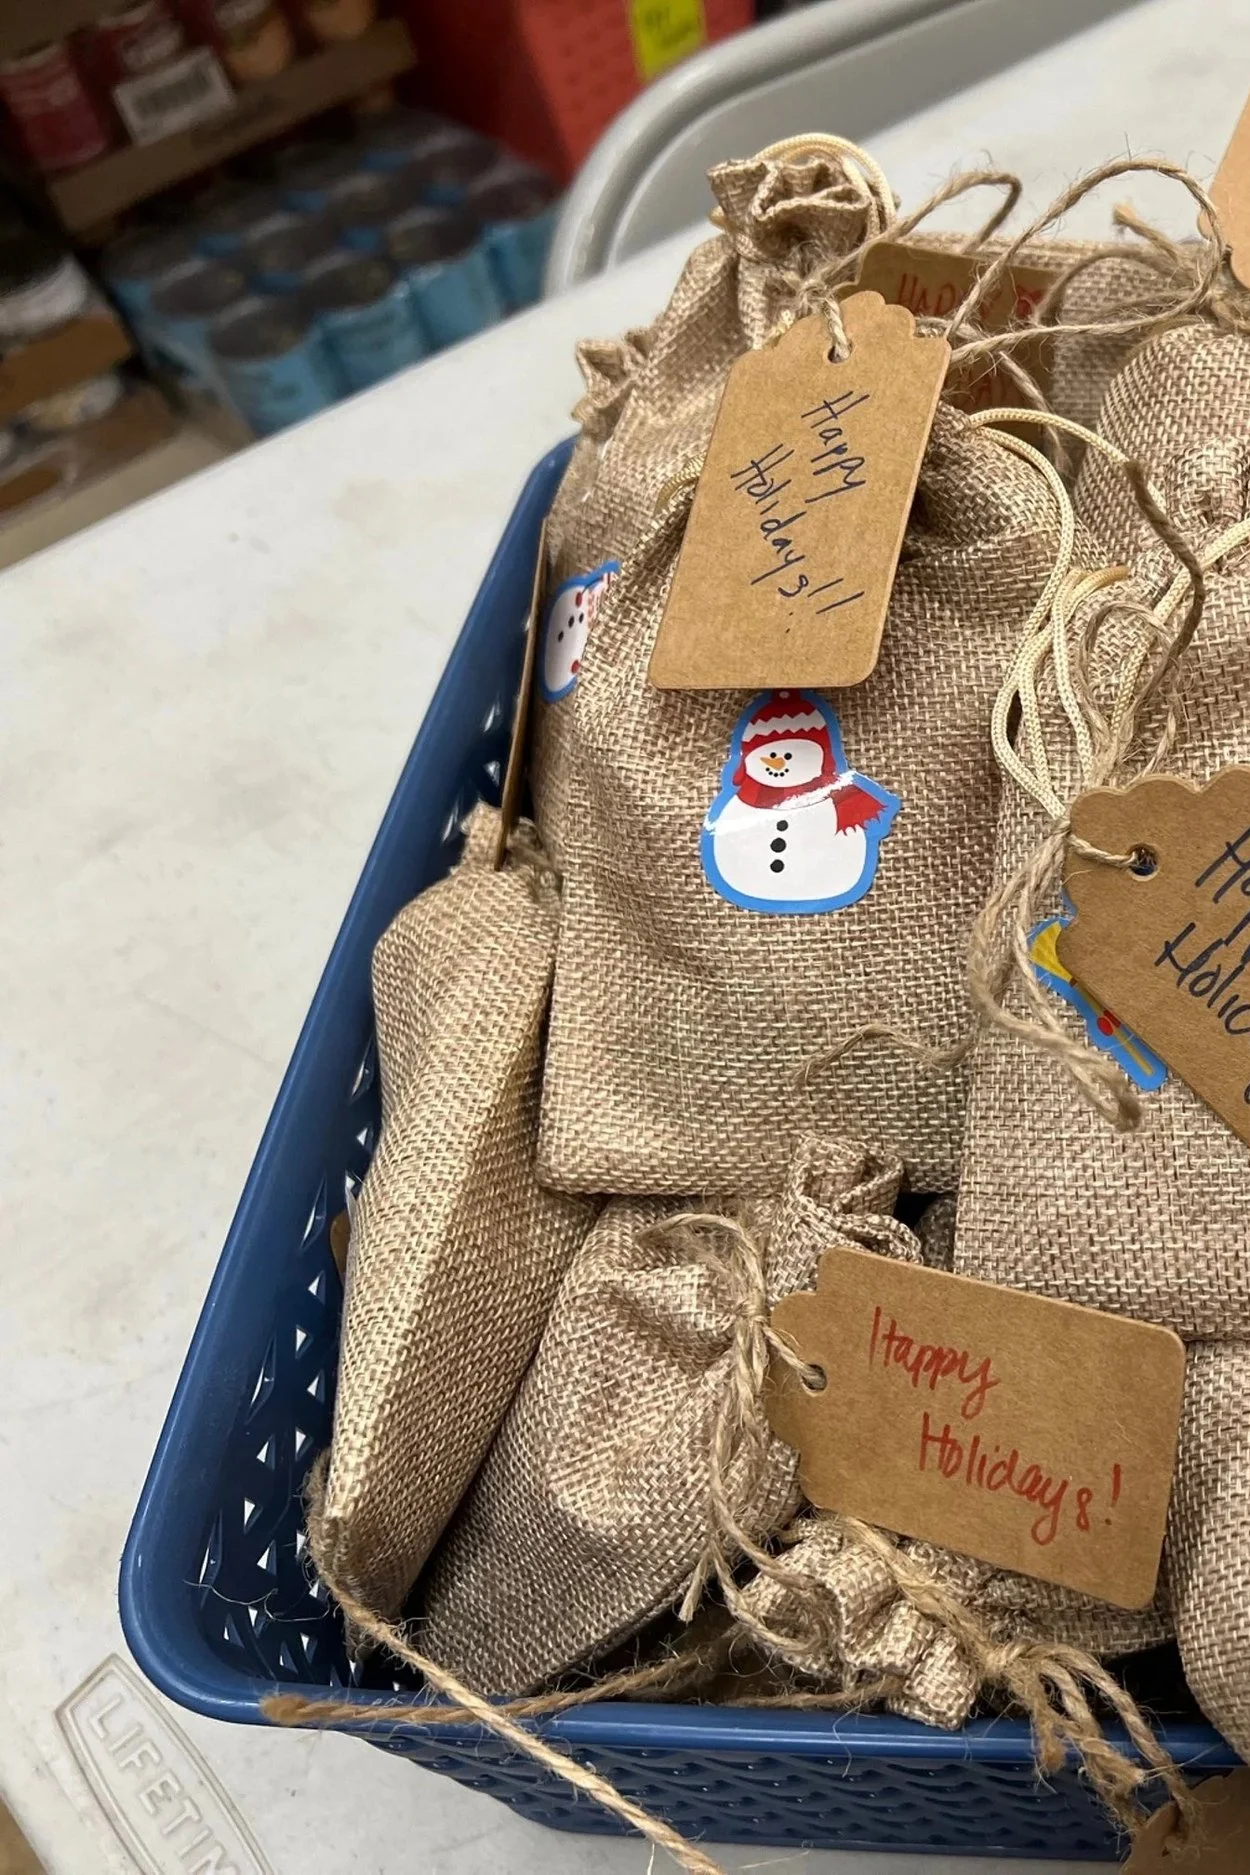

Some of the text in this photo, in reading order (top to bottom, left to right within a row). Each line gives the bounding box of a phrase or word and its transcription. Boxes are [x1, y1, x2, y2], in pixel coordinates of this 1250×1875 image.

[800, 390, 870, 504] Happy
[730, 443, 866, 635] Holidays!!
[868, 1306, 999, 1421] Happy
[918, 1411, 1122, 1546] Holidays!
